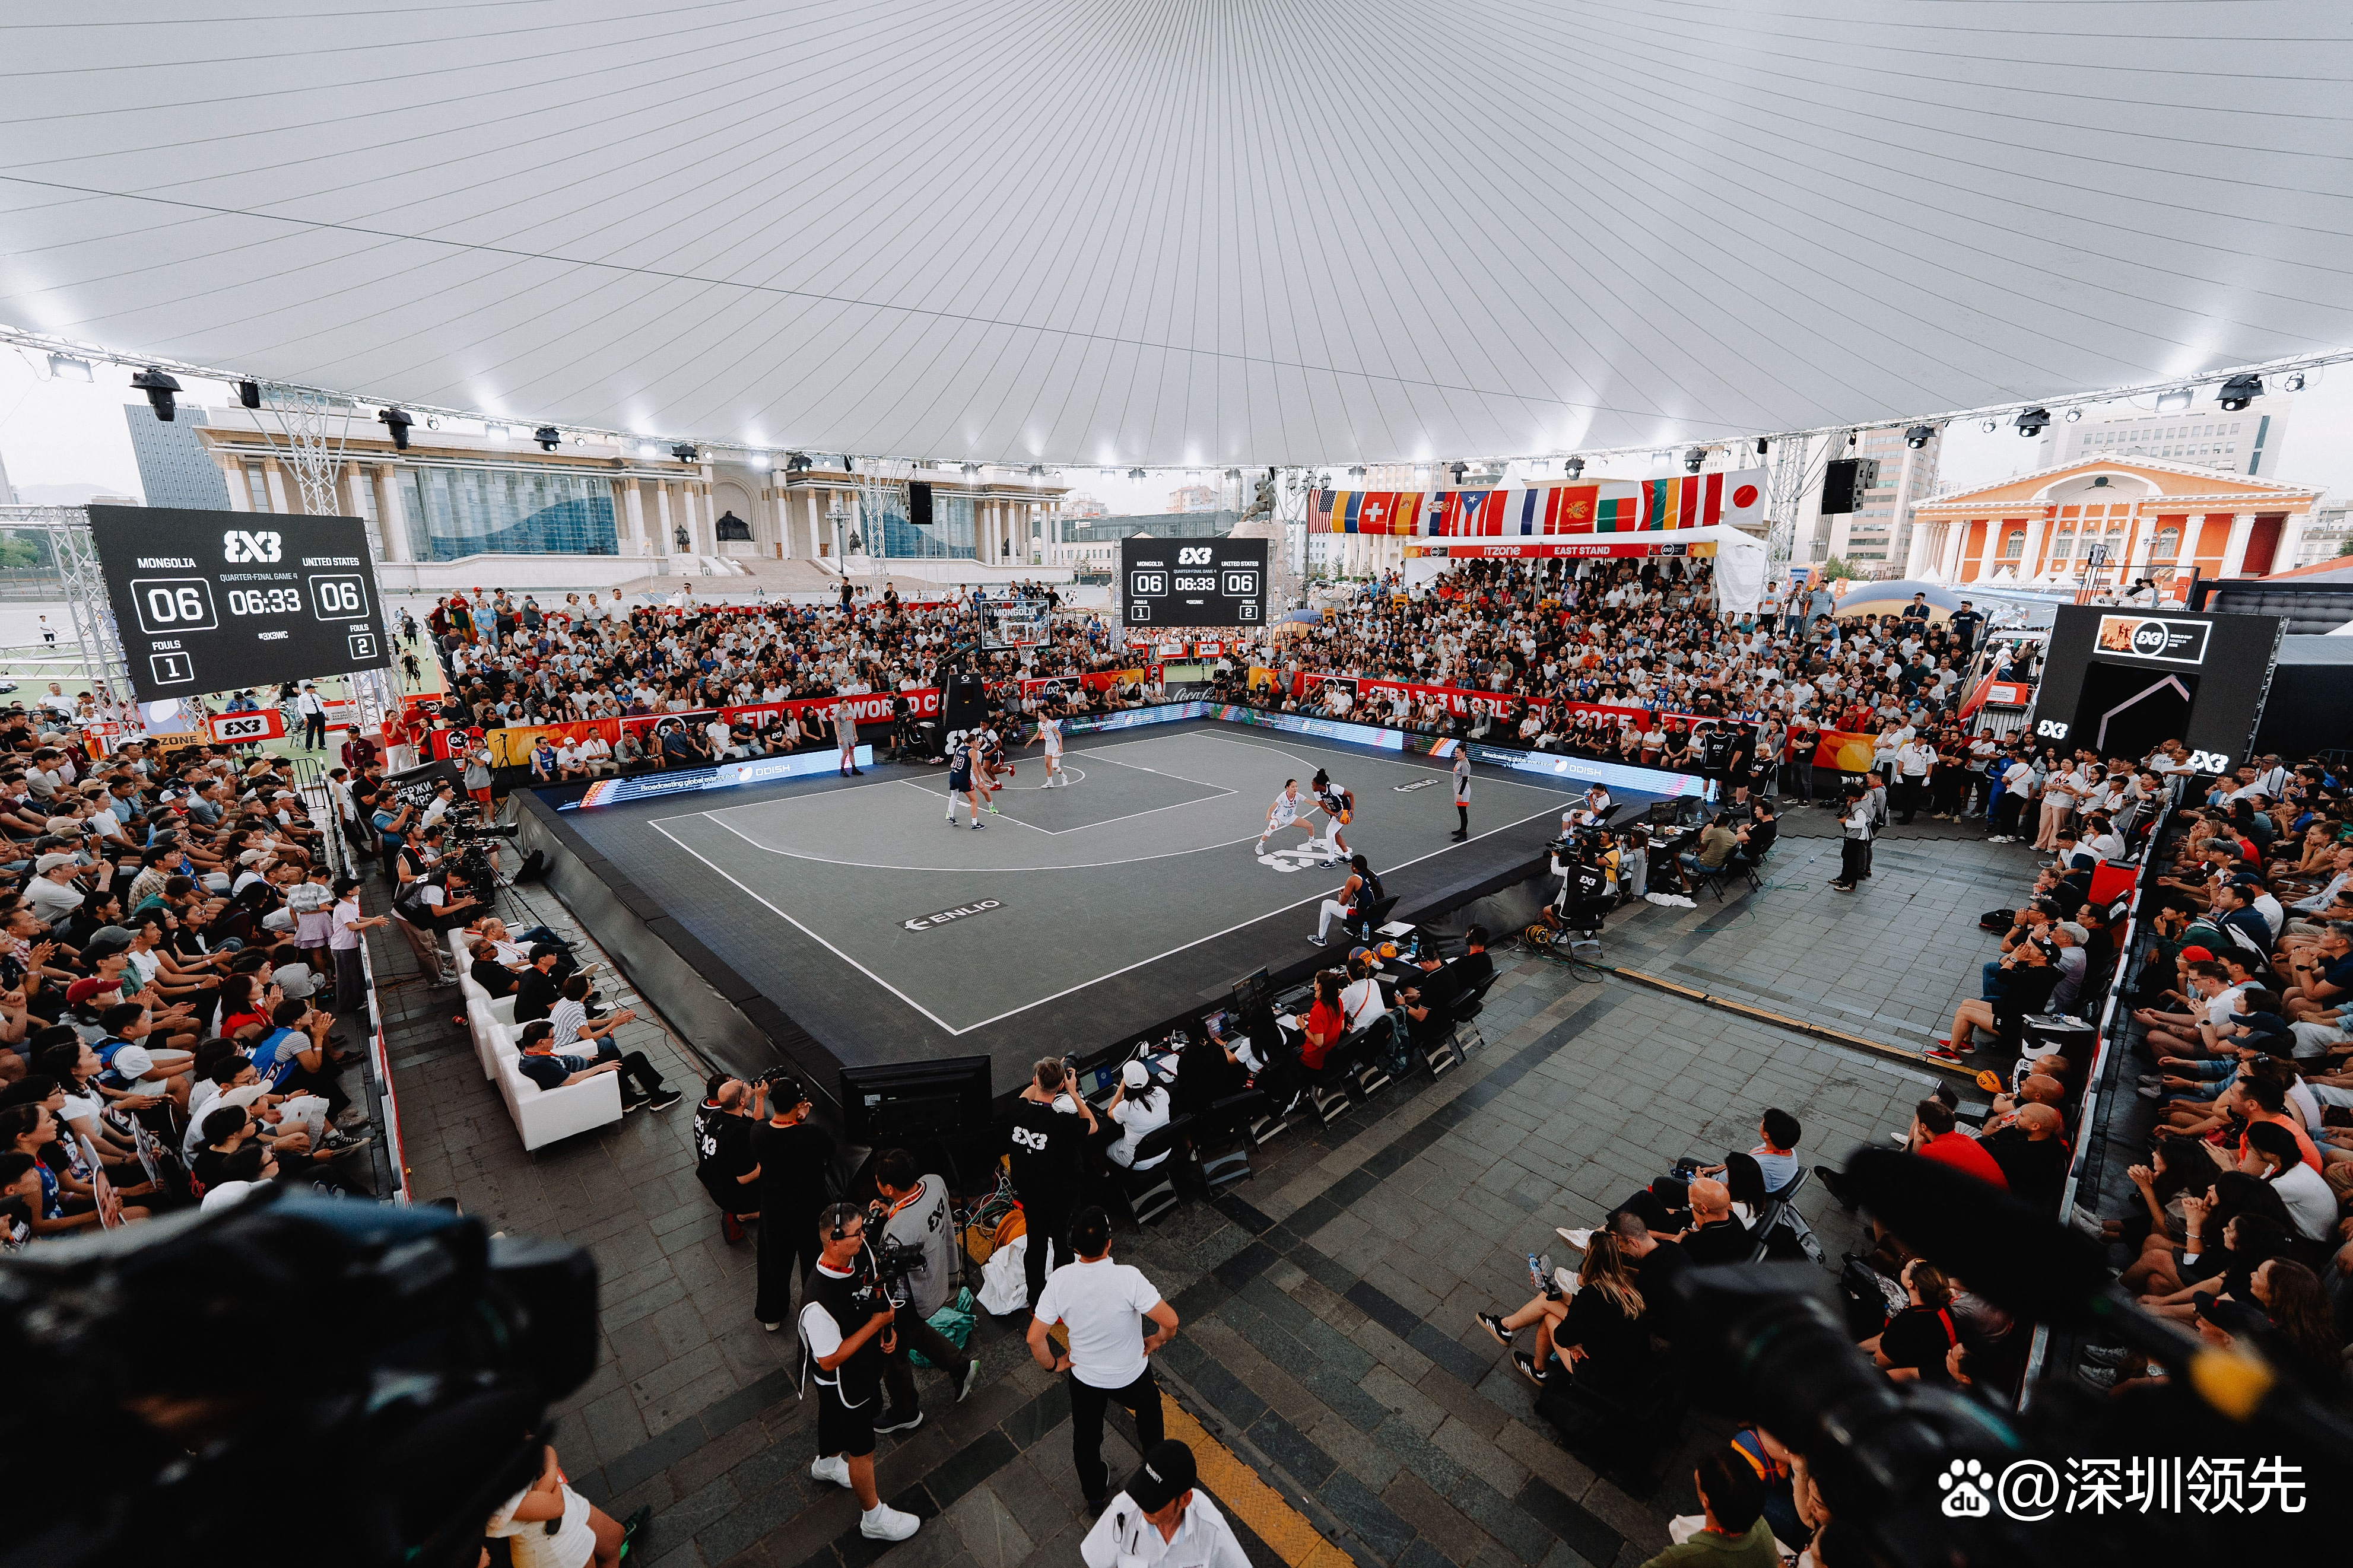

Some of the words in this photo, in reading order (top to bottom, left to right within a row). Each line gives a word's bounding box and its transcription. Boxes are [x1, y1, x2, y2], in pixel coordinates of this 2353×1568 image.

[1554, 547, 1577, 555] EAST
[1579, 546, 1610, 555] STAND
[137, 558, 196, 568] MONGOLIA
[302, 557, 331, 567] UNITED
[332, 556, 360, 566] STATES
[220, 573, 273, 582] QUARTER-FINAL
[1137, 575, 1162, 592] 06
[1175, 577, 1215, 591] 06:33
[1228, 575, 1253, 591] 06
[228, 588, 301, 615] 06:33
[319, 583, 359, 610] 06
[148, 587, 202, 622] 06
[994, 608, 1037, 617] MONGOLIA
[1138, 608, 1144, 618] 1
[1244, 608, 1252, 618] 2
[350, 623, 369, 632] FOULS
[258, 631, 288, 641] #3X3WC
[152, 640, 181, 650] FOULS
[357, 638, 369, 654] 2
[165, 659, 180, 678] 1
[849, 696, 919, 720] WORD
[160, 736, 198, 746] ZONE
[1482, 751, 1512, 762] Broadcasting
[1512, 756, 1527, 764] global
[640, 780, 684, 791] Broadcasting
[684, 777, 704, 787] global
[704, 775, 725, 784] events
[929, 900, 1000, 923] ENLIO
